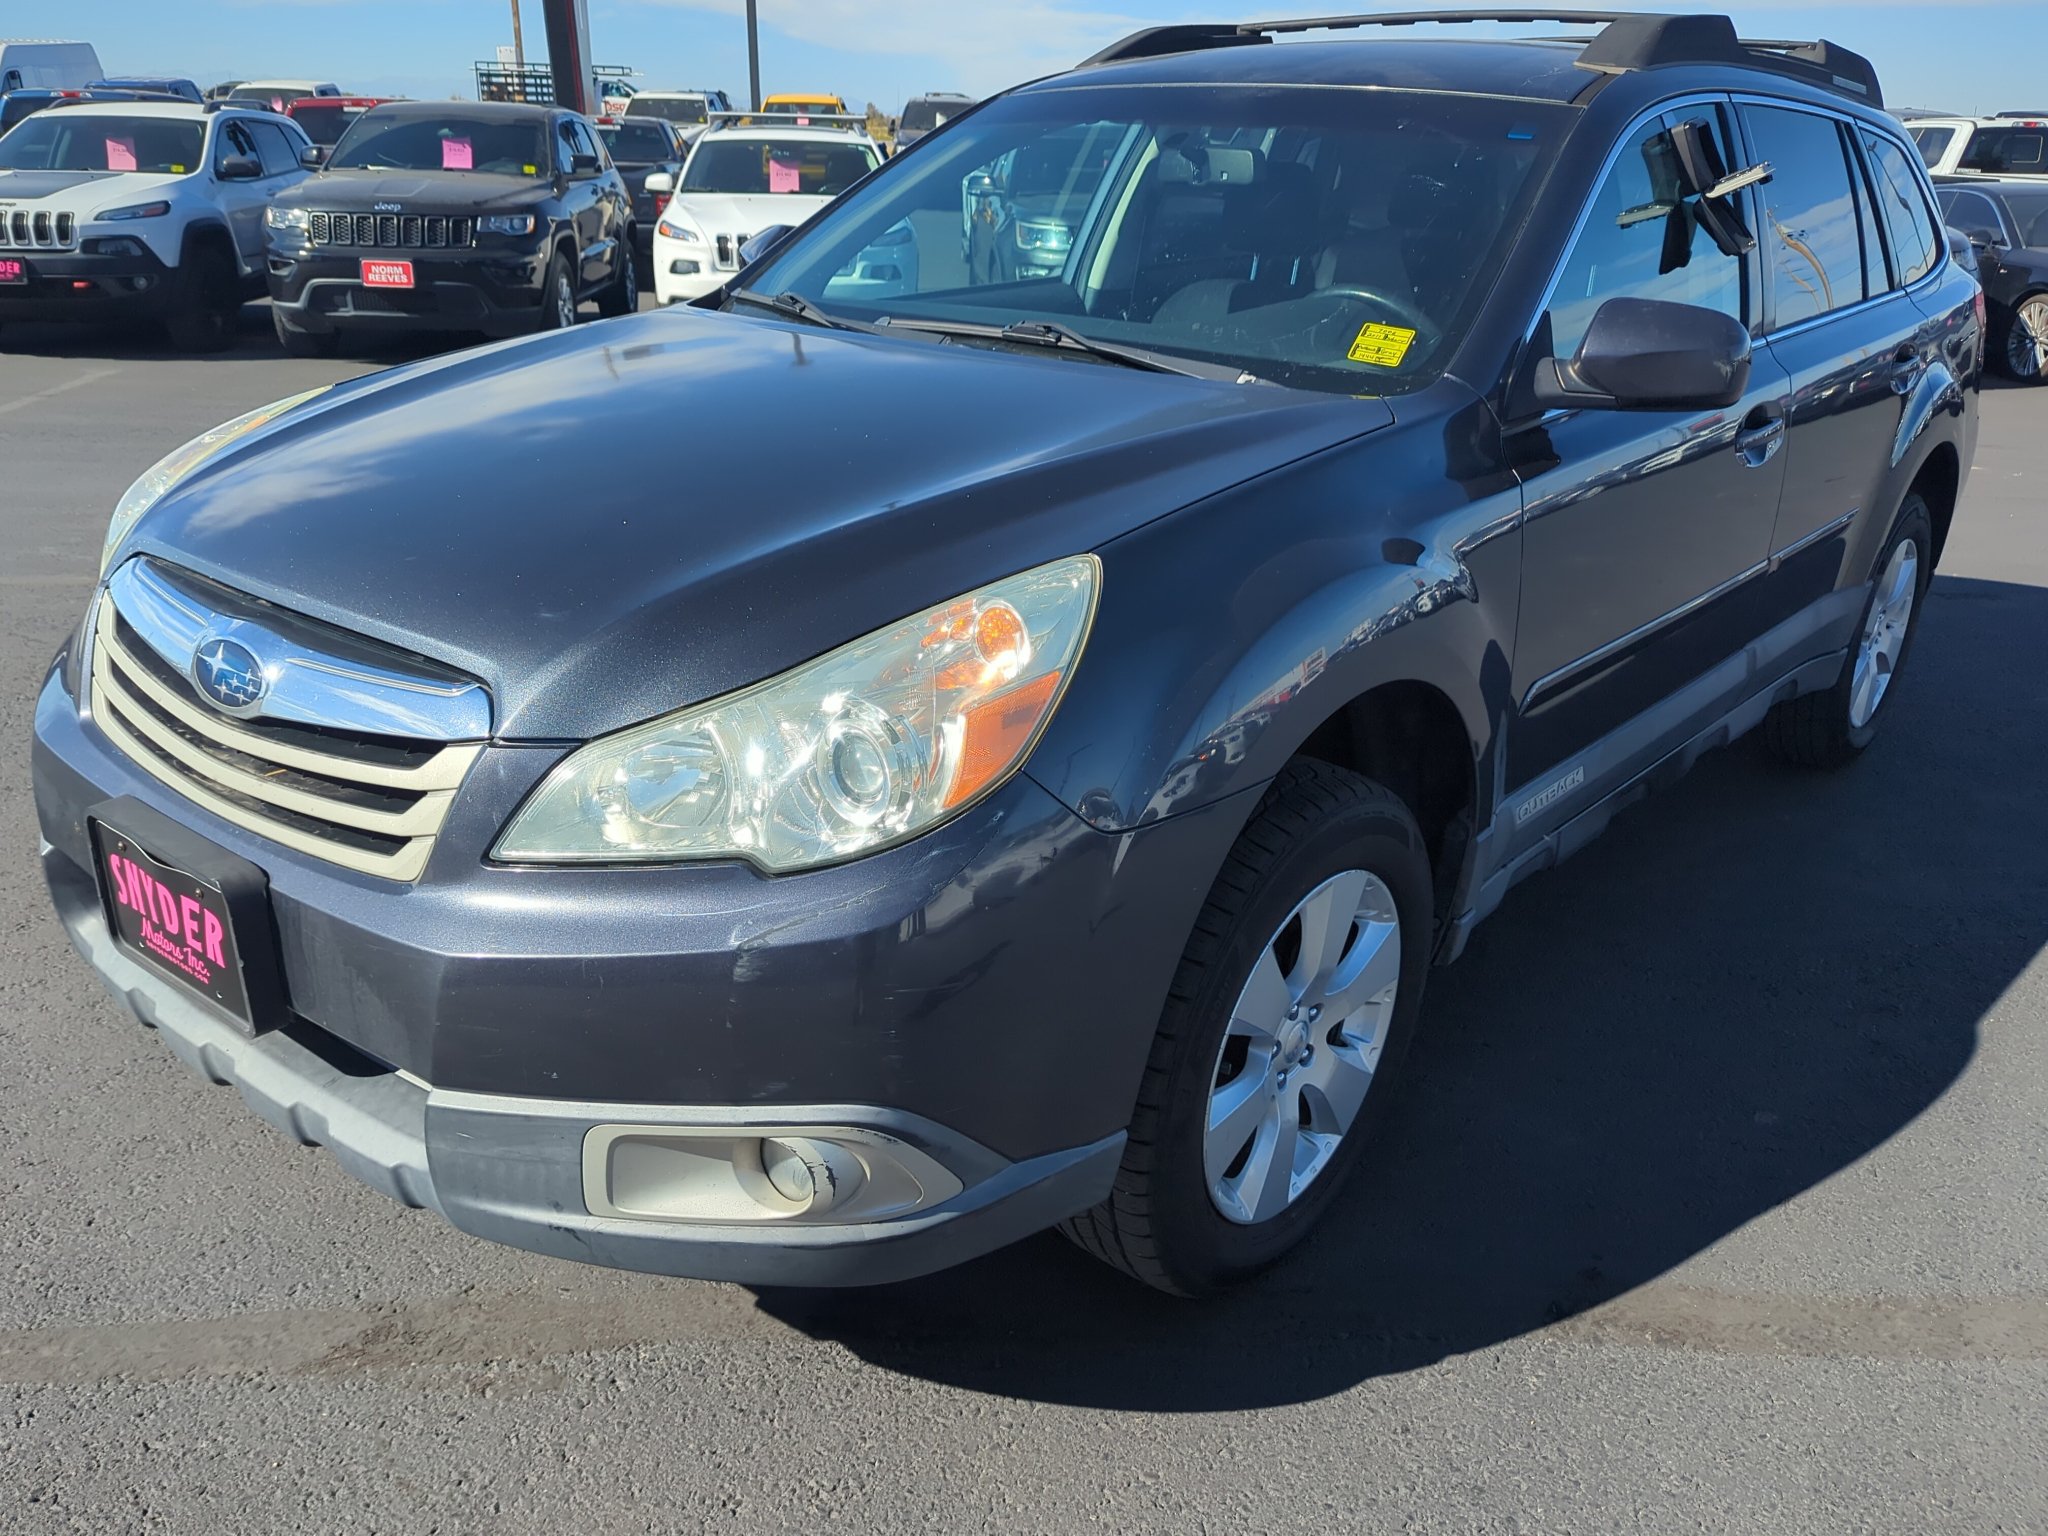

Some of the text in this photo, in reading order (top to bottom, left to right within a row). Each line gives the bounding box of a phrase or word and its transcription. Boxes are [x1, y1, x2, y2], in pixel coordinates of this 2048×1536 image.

[374, 202, 402, 212] Jeep
[368, 273, 408, 283] REEVES
[371, 265, 403, 274] NORM
[1518, 767, 1584, 822] OUTBACK
[110, 854, 226, 969] SNYDER
[140, 917, 211, 977] Motors Inc.
